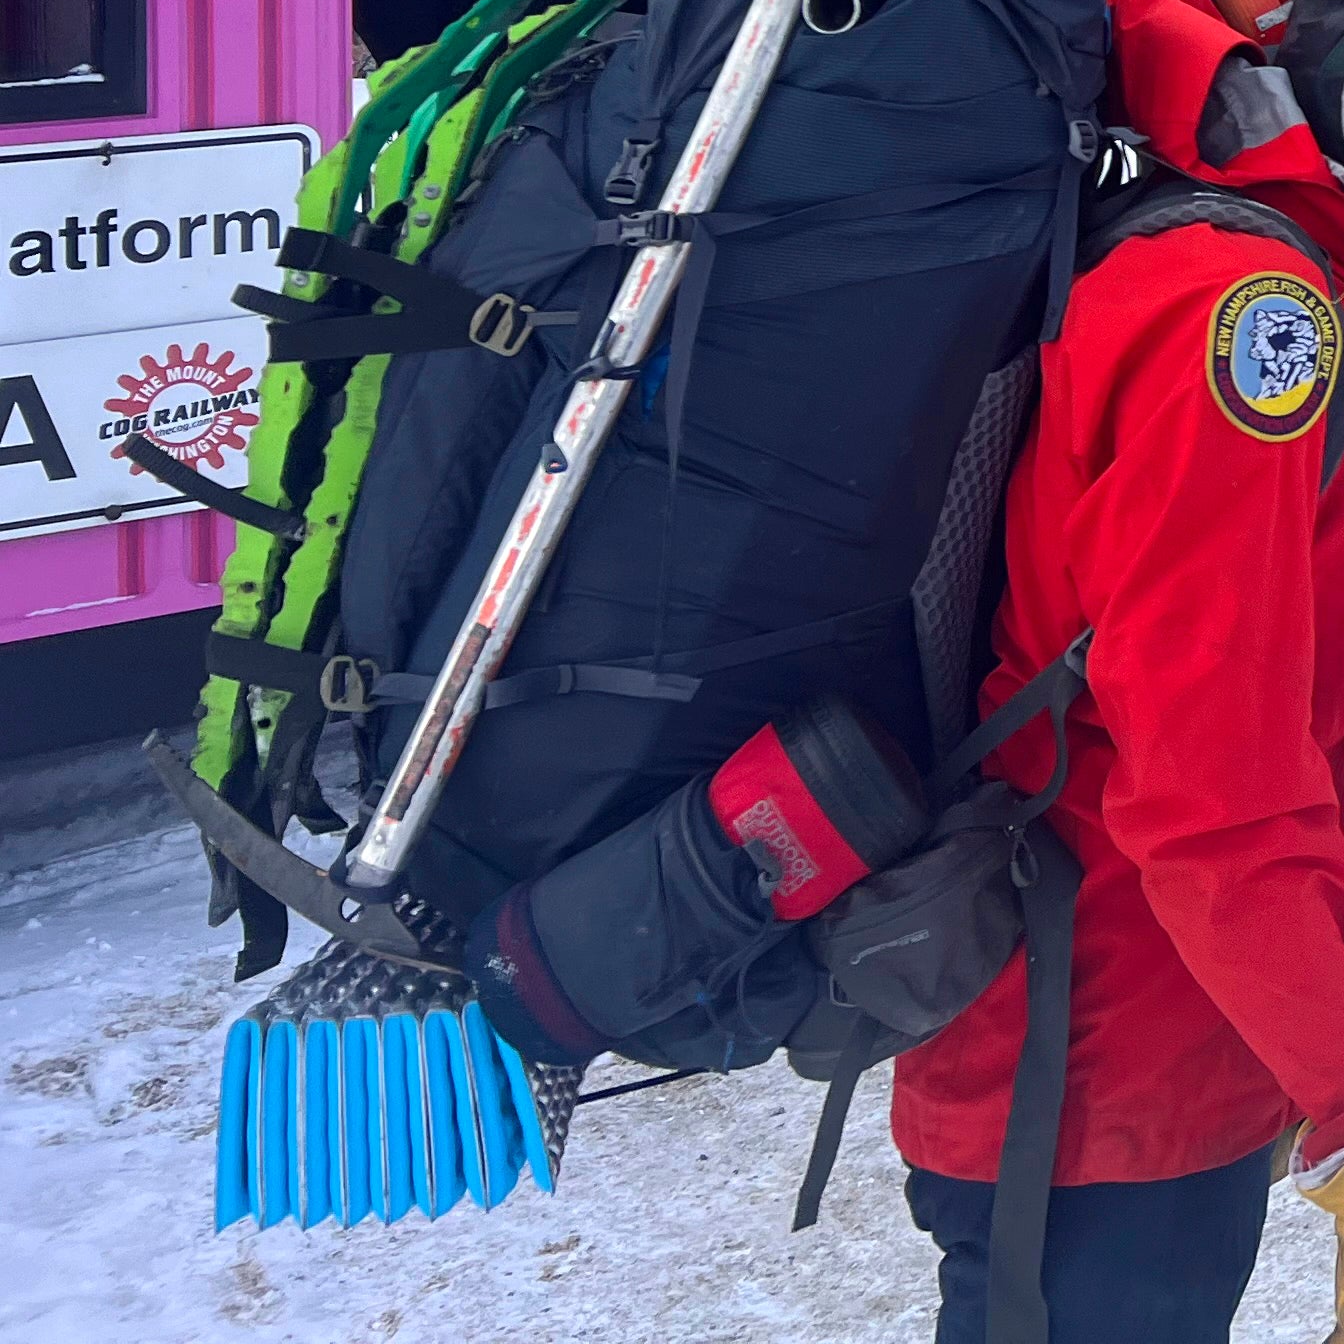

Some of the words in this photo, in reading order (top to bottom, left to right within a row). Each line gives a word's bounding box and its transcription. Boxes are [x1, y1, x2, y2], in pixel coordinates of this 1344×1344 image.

[9, 207, 281, 277] atform
[1221, 279, 1280, 327] HAMPSHIRE
[1280, 281, 1307, 302] FISH
[1306, 296, 1317, 309] &
[1216, 325, 1233, 356] NEW
[1315, 308, 1335, 344] GAME
[133, 376, 165, 403] THE
[166, 365, 226, 389] MOUNT
[98, 413, 148, 440] COG
[153, 388, 260, 427] RAILWAY
[154, 417, 214, 438] thecog.com
[143, 415, 235, 461] HINGTON
